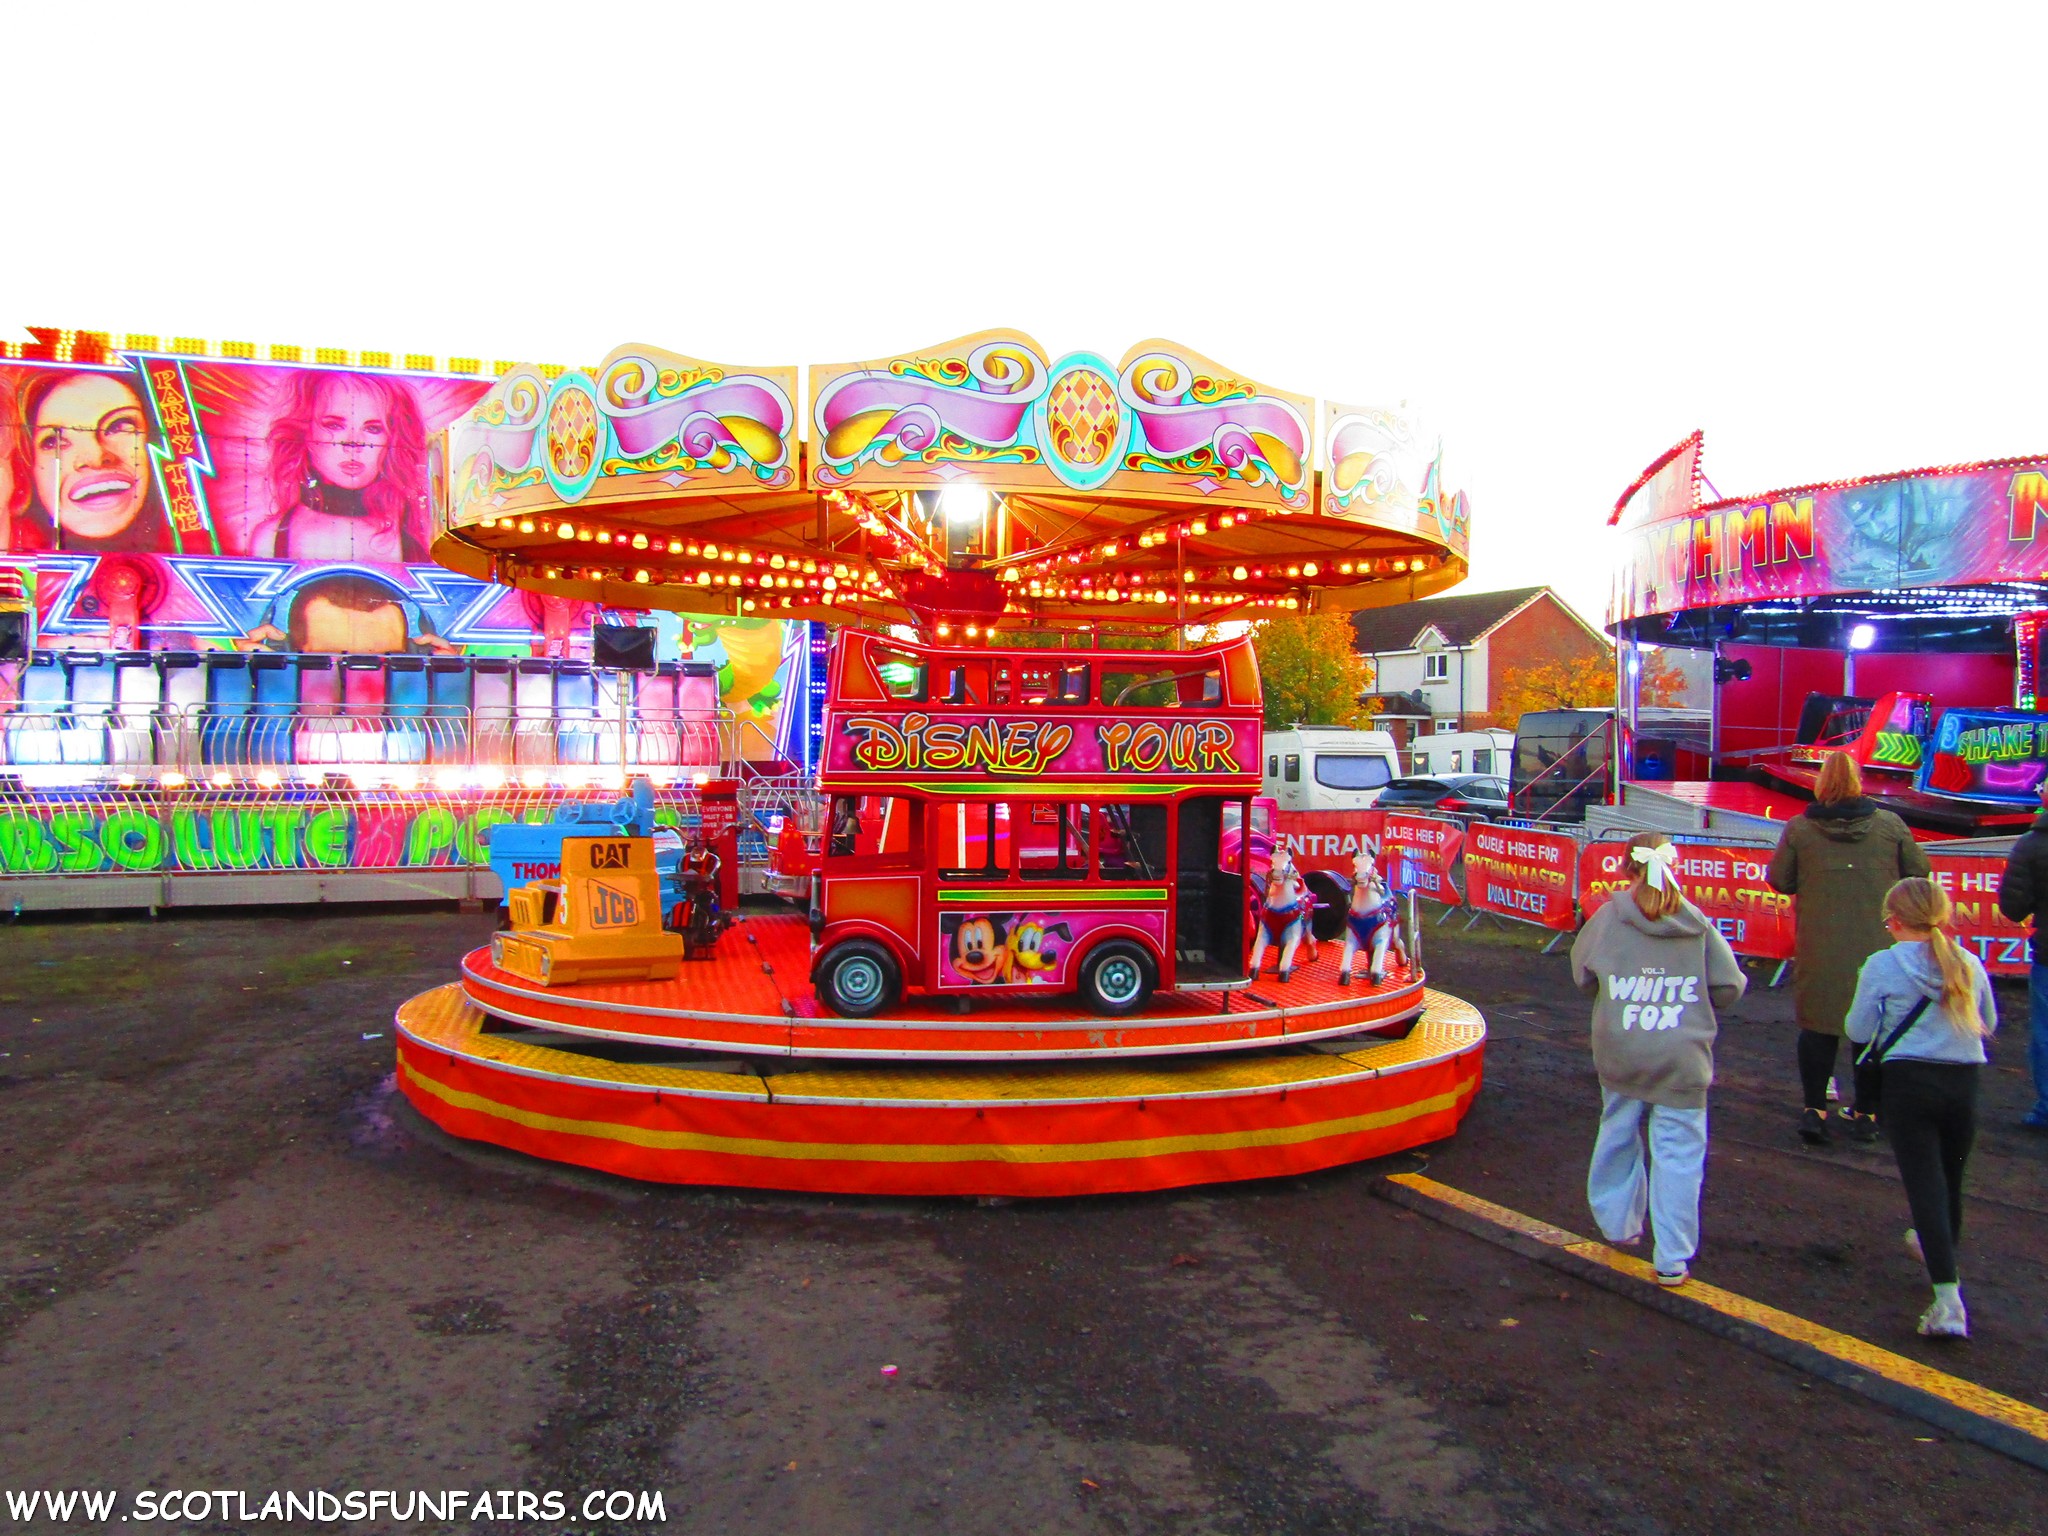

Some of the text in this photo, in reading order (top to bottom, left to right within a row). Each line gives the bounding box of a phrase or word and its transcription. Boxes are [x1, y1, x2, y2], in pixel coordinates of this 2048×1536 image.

[153, 369, 202, 533] PARTY TIME
[1957, 722, 2035, 765] SHAKE
[590, 843, 631, 869] CAT
[1275, 833, 1381, 857] ENTRAN
[1538, 845, 1559, 864] FOR
[512, 862, 561, 880] THOM
[1673, 857, 1726, 879] HERE
[593, 885, 636, 925] JCB
[1694, 885, 1793, 916] MASTER
[1608, 974, 1699, 1003] WHITE
[1622, 1004, 1684, 1031] FOX
